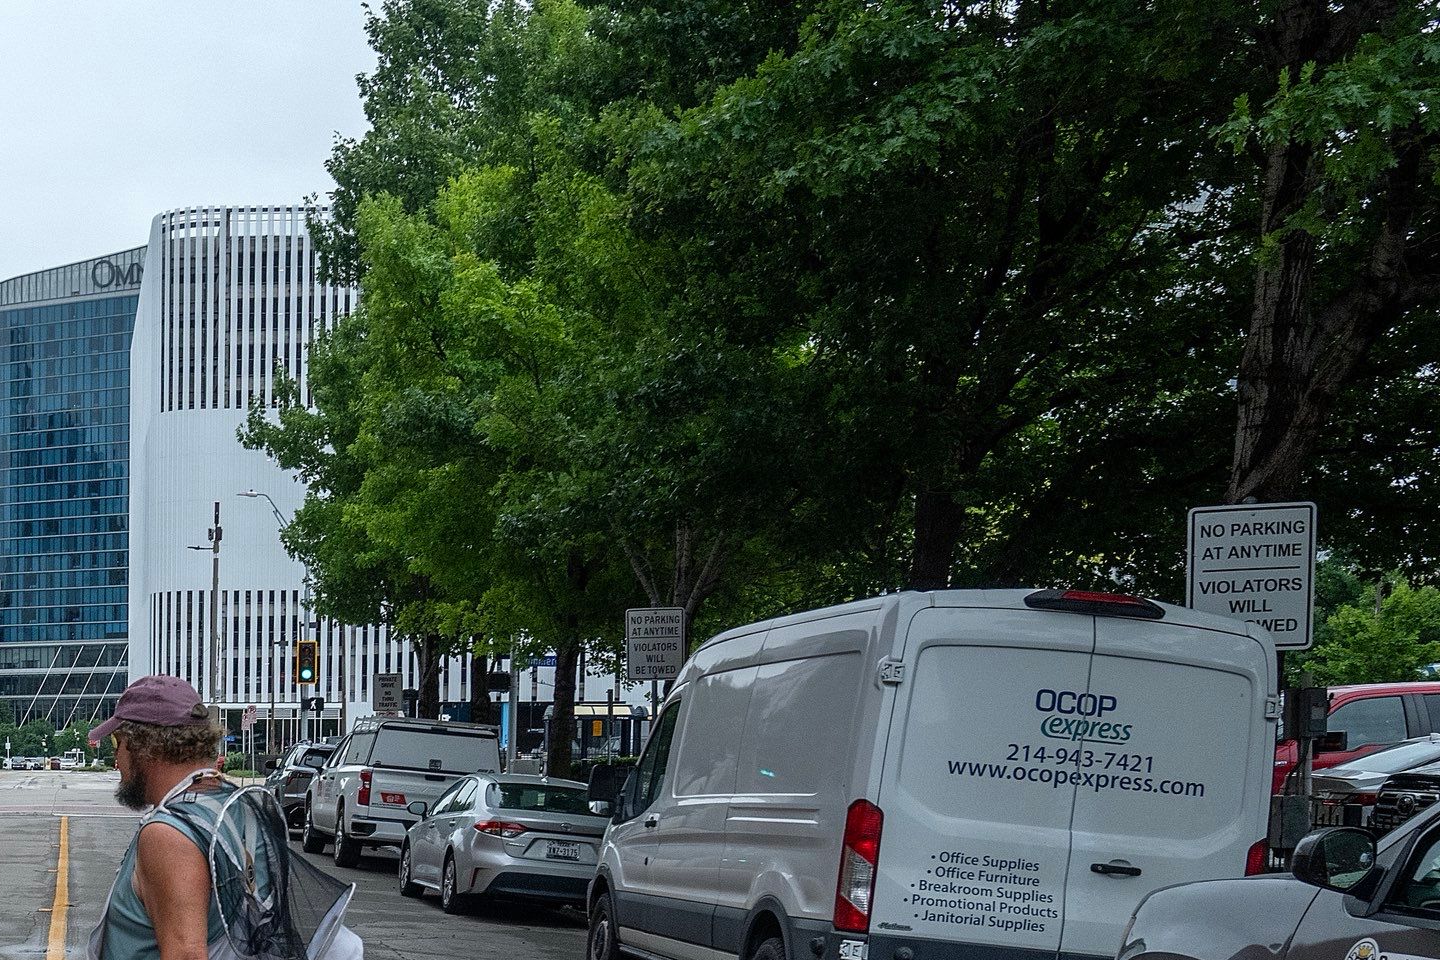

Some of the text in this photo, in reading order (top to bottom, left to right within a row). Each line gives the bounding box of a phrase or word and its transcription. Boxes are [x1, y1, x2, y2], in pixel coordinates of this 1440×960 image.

[1200, 520, 1305, 539] NO PARKING
[1202, 543, 1302, 560] AT ANYTIME
[1199, 577, 1303, 595] VIOLATORS
[1229, 599, 1273, 614] WILL
[631, 615, 680, 625] NO PARKING
[1244, 618, 1298, 632] WED
[632, 627, 679, 636] AT ANYTIME
[633, 643, 678, 652] VIOLATORS
[646, 654, 666, 663] WILL
[635, 665, 676, 675] BE TOWED
[1035, 689, 1117, 718] OCOP
[1047, 716, 1133, 742] express
[1006, 743, 1154, 774] 214-943-7421
[948, 760, 1205, 797] www.ocopexpress.com
[939, 851, 1040, 872] Office Supplies
[935, 866, 1040, 887] Office Furniture
[919, 880, 1054, 904] Breakroom Supplies
[912, 894, 1058, 919] Promotional Products
[921, 910, 985, 927] Janitorial
[988, 916, 1046, 933] Supplies
